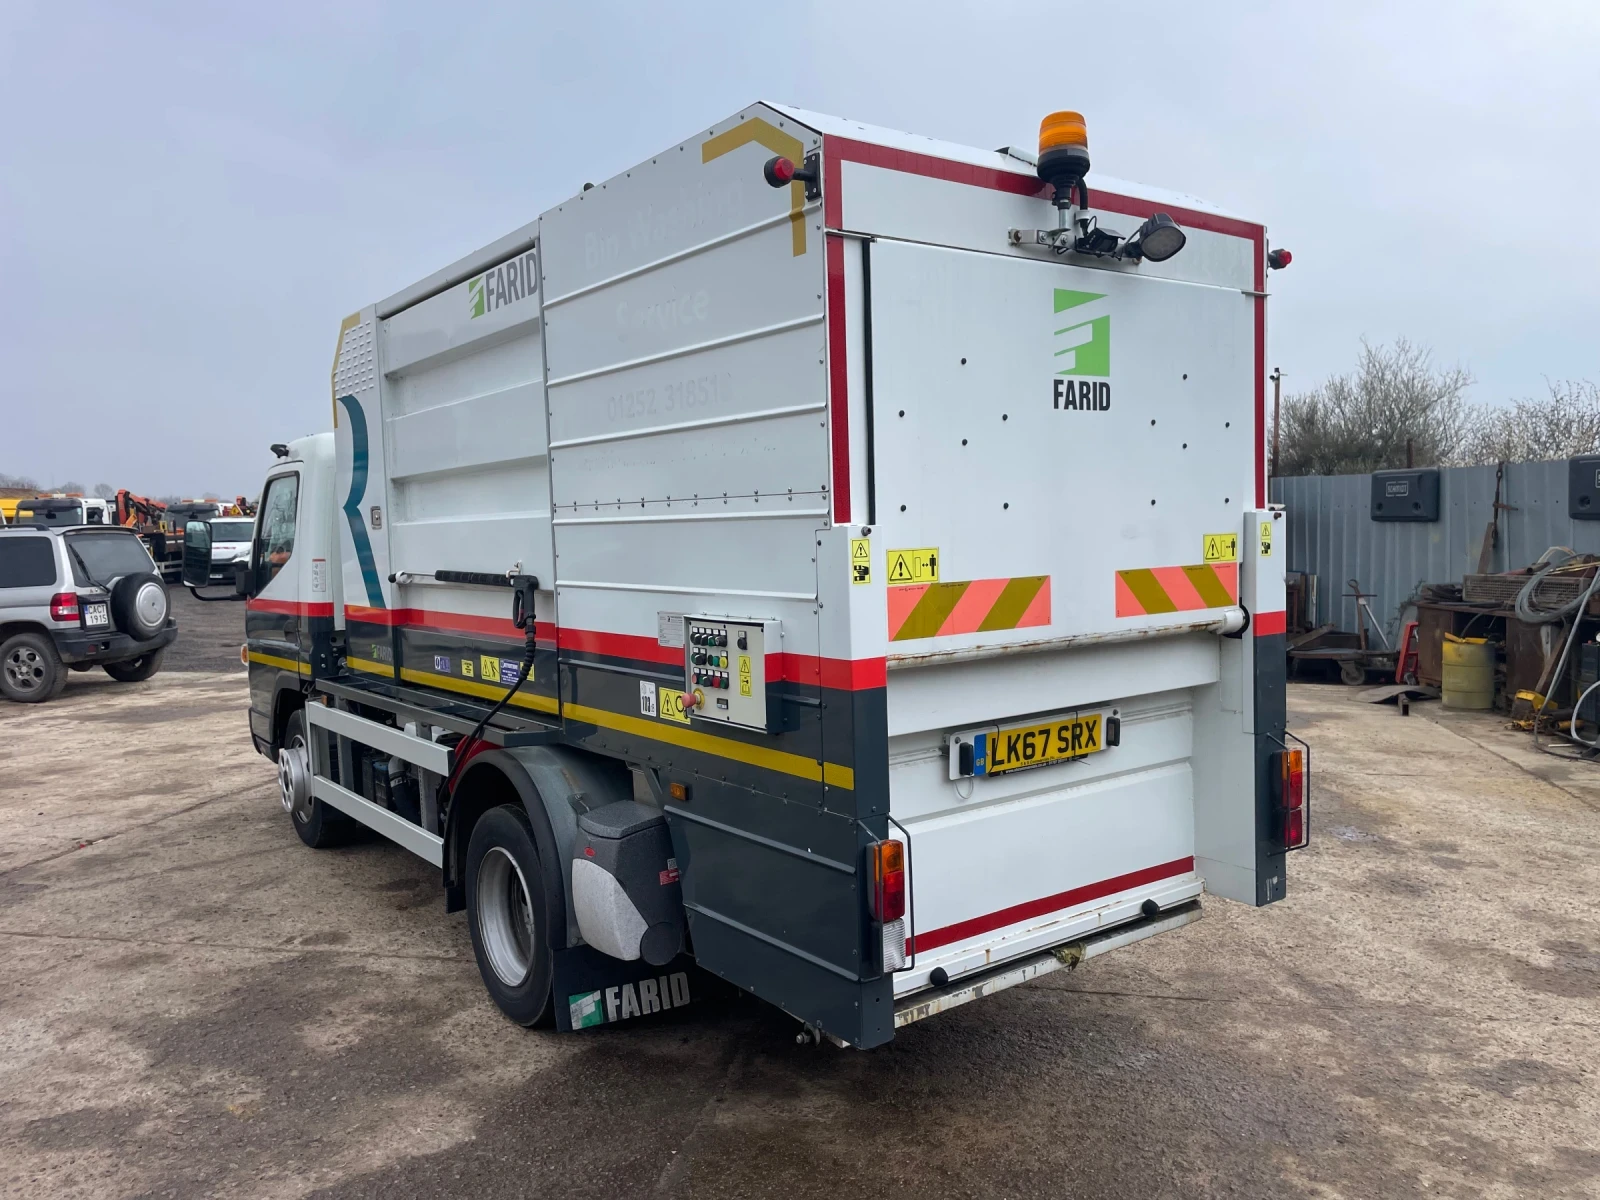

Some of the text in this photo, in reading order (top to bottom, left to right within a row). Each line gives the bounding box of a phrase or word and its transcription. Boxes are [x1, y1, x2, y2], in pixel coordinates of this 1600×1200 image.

[486, 252, 538, 312] FARID
[1053, 379, 1111, 411] FARID
[88, 605, 105, 614] CACT
[90, 615, 107, 624] 1915
[991, 720, 1097, 767] LK67 SRX
[976, 758, 985, 767] GB
[605, 972, 690, 1022] FARID
